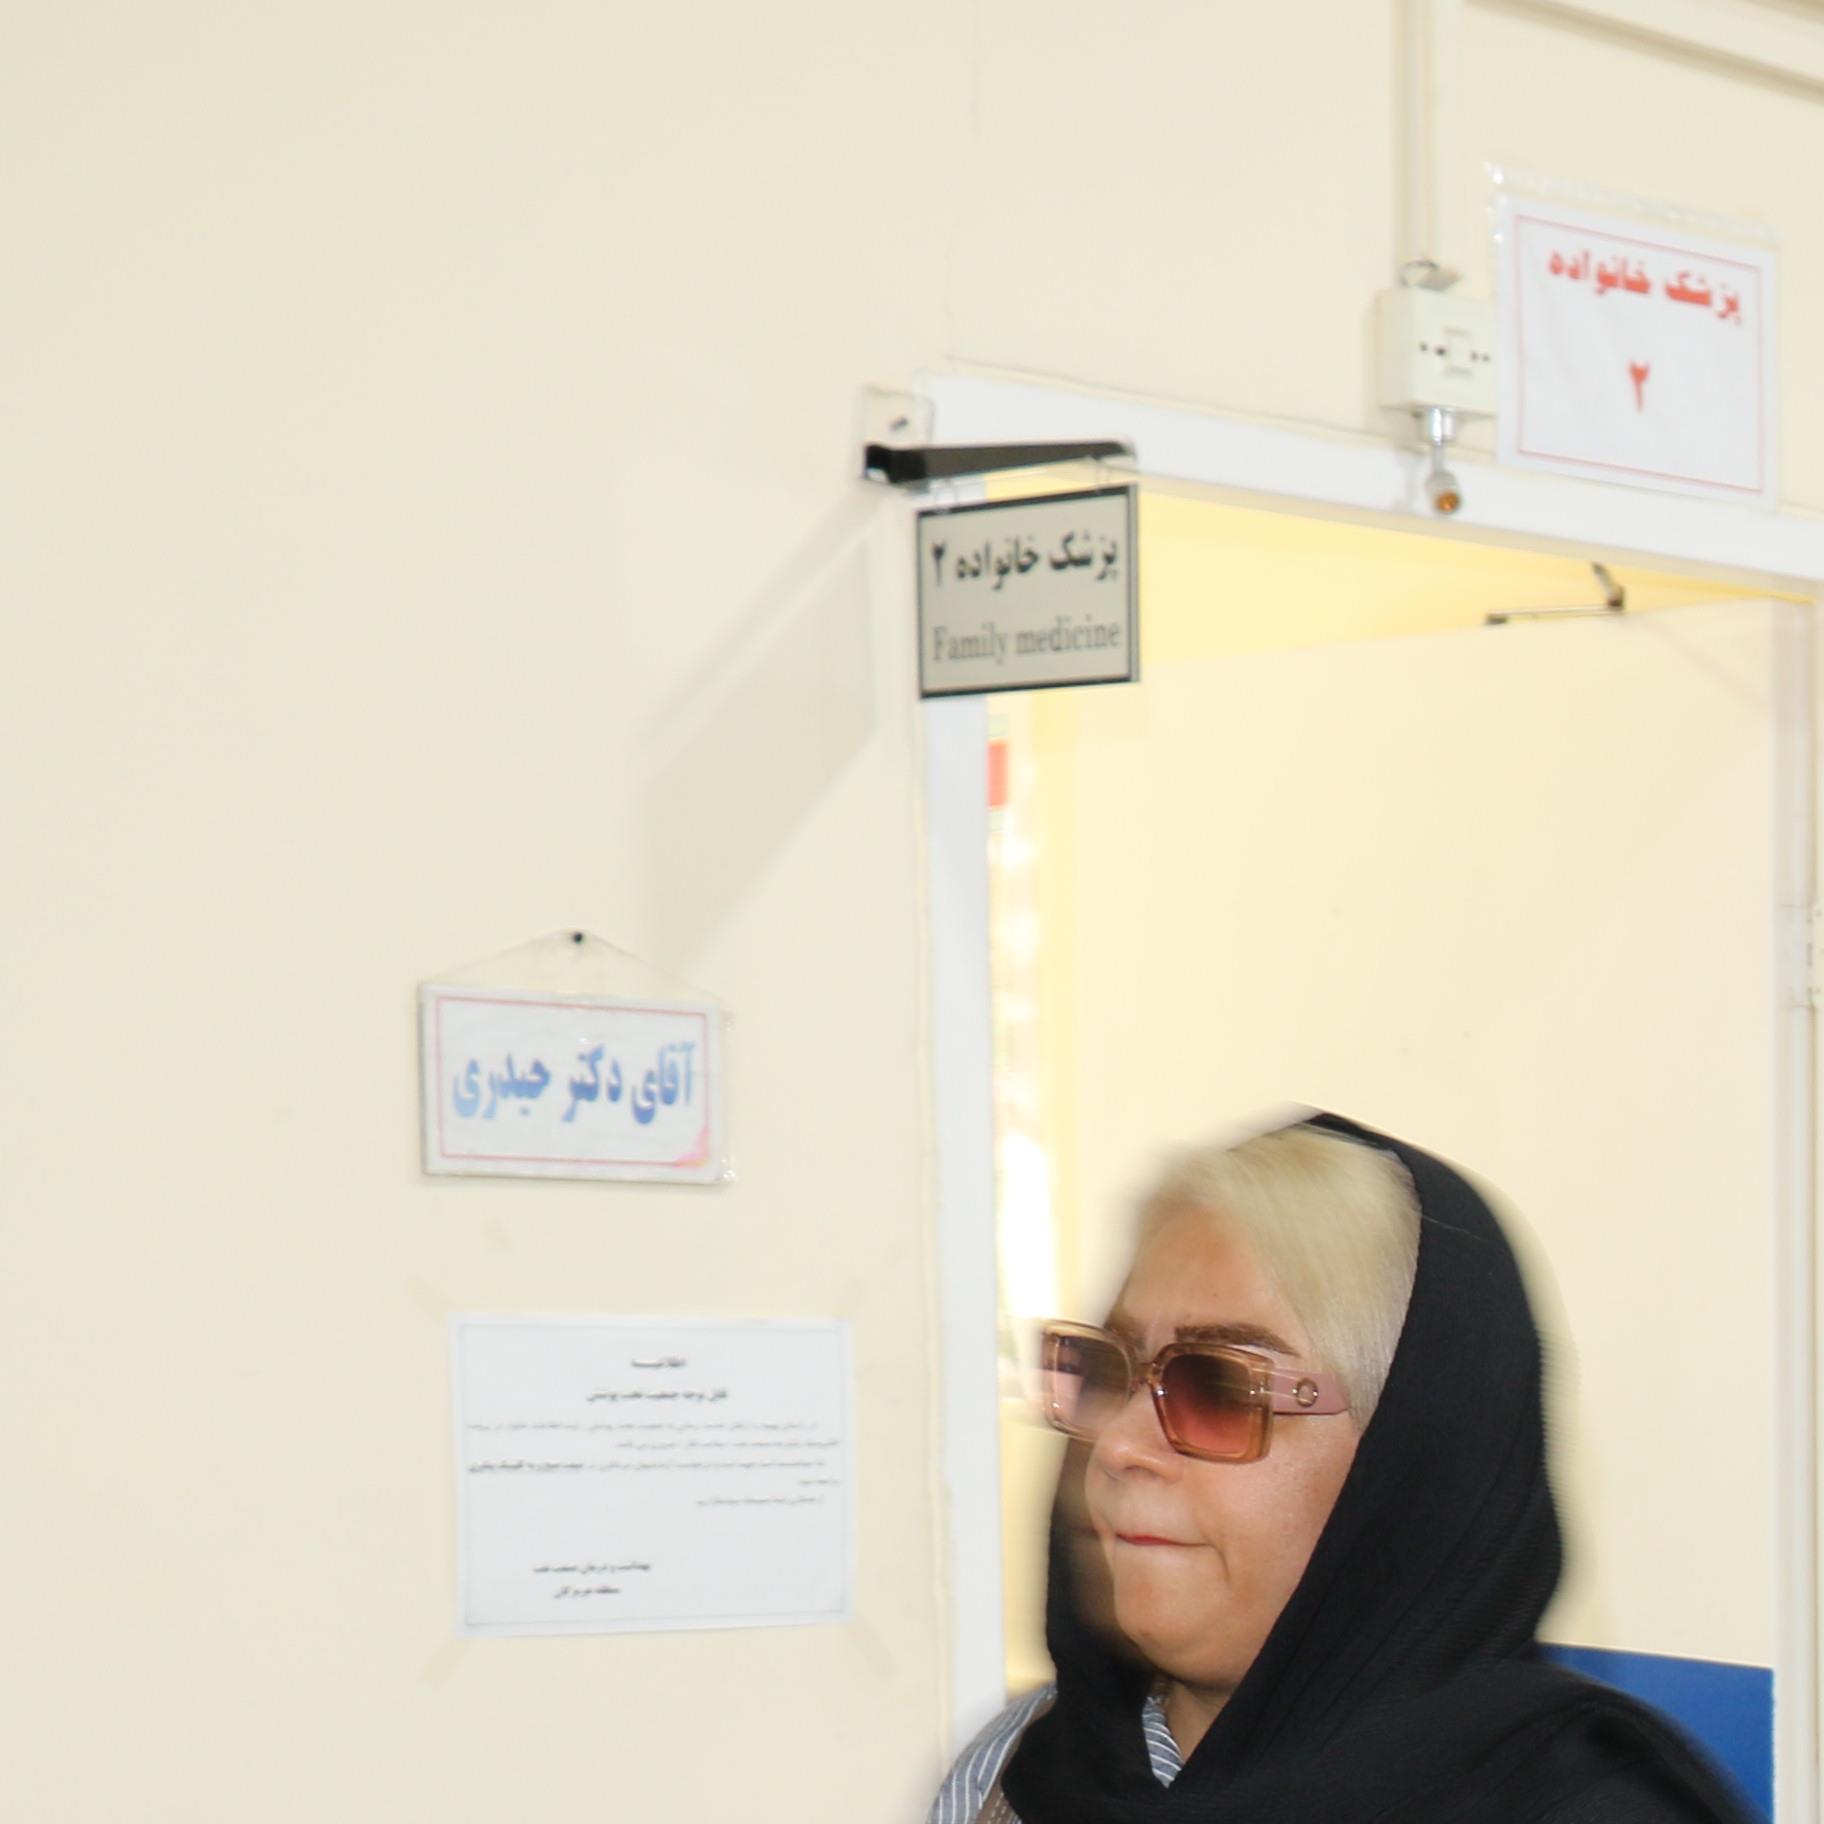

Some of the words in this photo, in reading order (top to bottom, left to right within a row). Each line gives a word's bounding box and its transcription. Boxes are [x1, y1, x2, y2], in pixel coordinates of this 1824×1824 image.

[1547, 249, 1651, 295] خانواده
[1663, 270, 1741, 325] پزشک
[1629, 360, 1650, 413] ۲
[932, 541, 945, 586] ۲
[956, 534, 1040, 591] خانواده
[1050, 530, 1118, 581] پزشک
[932, 622, 1008, 665] Family
[1015, 613, 1121, 655] medicine
[453, 1053, 552, 1120] حیدری
[562, 1043, 623, 1123] دکتر
[631, 1041, 695, 1125] آقای
